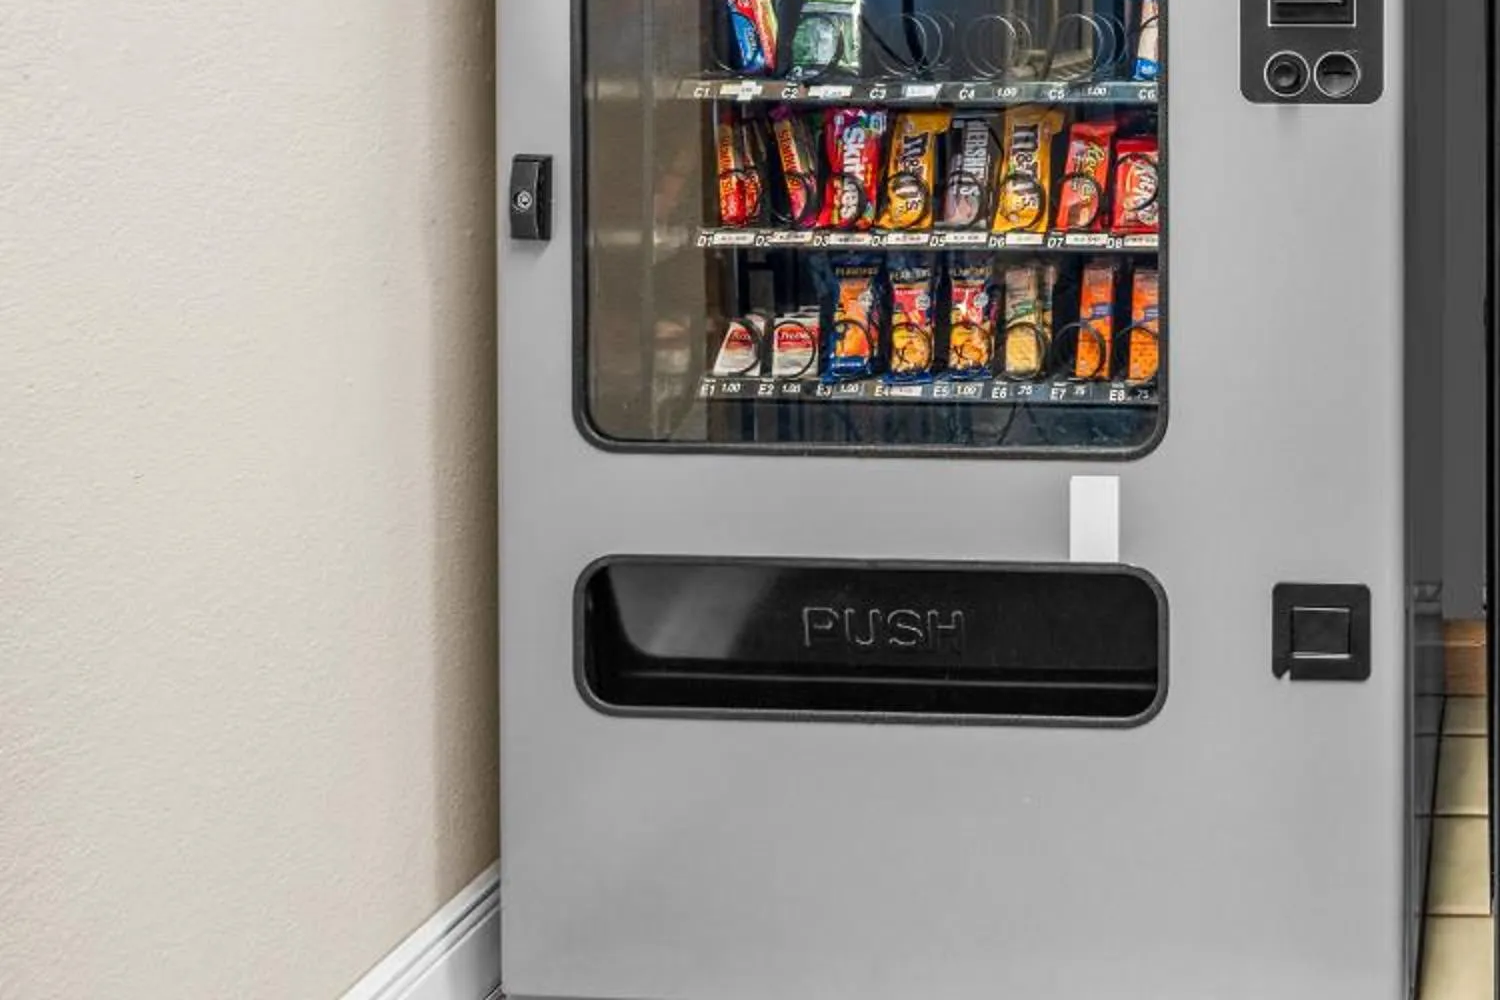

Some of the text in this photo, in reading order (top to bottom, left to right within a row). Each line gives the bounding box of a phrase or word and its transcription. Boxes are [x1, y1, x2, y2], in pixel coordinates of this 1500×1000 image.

[693, 87, 711, 98] C1
[781, 88, 800, 99] C2
[959, 89, 975, 100] C4
[1049, 89, 1065, 100] C5
[1137, 88, 1156, 100] C6
[699, 385, 715, 397] E1
[720, 383, 742, 393] 1.00
[757, 385, 774, 397] E2
[839, 383, 860, 393] 1.00
[932, 386, 949, 397] E5
[991, 386, 1007, 399] E6
[1050, 388, 1066, 399] E7
[1108, 389, 1125, 401] E8
[803, 606, 966, 648] PUSH
